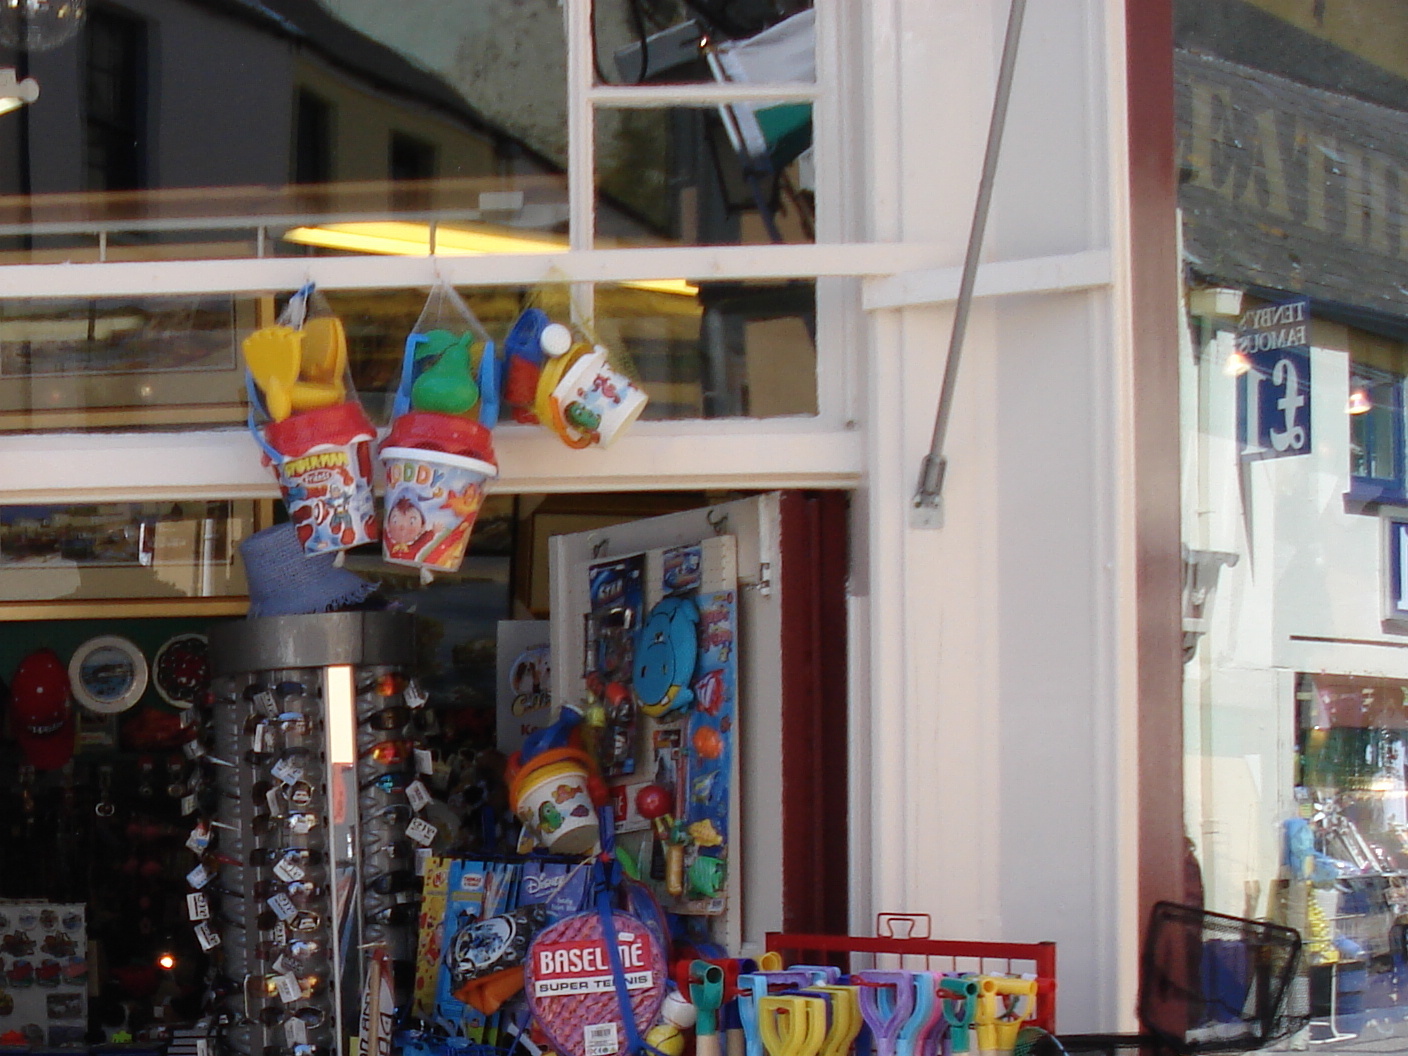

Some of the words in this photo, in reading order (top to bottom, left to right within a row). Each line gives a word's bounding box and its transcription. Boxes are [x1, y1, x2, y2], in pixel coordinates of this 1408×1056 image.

[387, 461, 445, 489] NODDY
[539, 943, 645, 975] BASELNE
[539, 981, 589, 992] SUPER
[594, 975, 648, 988] TENIS
